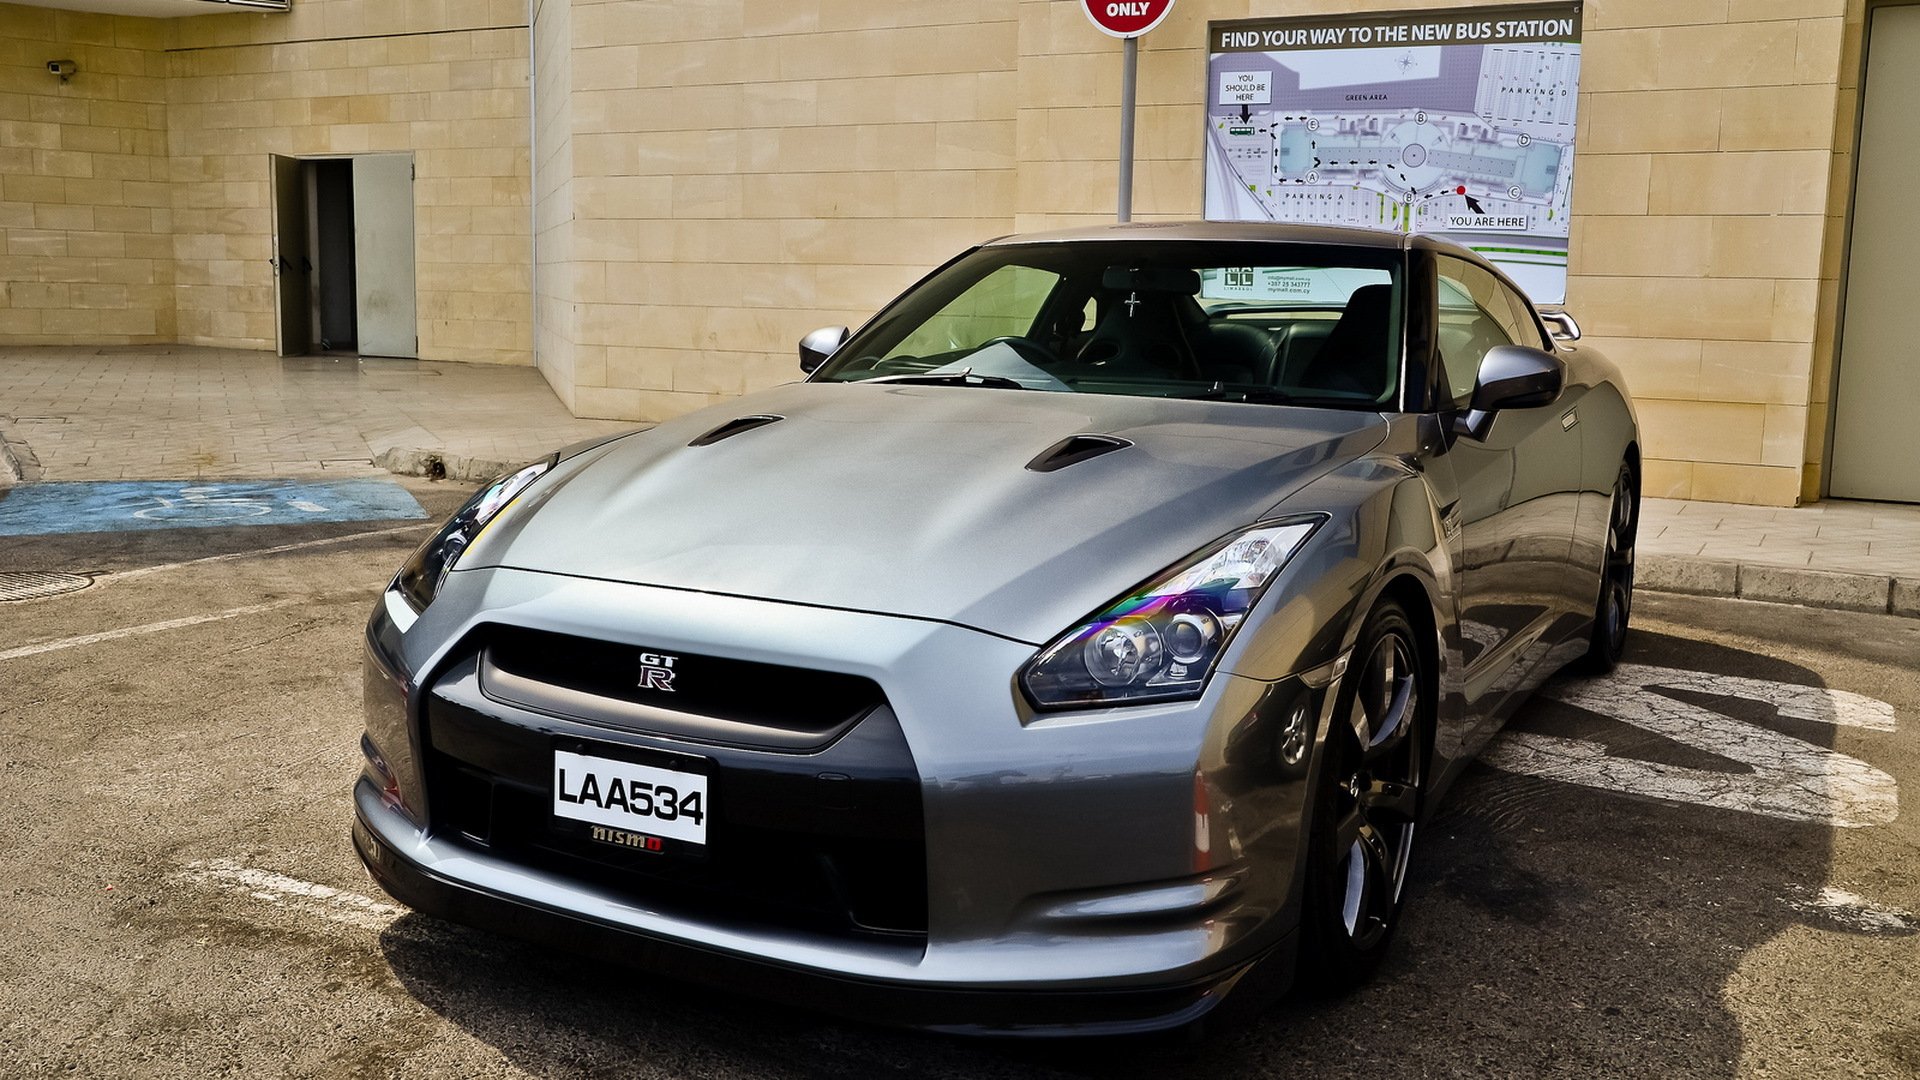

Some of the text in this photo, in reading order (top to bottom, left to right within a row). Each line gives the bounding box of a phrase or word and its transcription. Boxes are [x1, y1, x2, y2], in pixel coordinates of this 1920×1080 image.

[1106, 2, 1150, 17] ONLY
[1221, 19, 1573, 48] FIND YOUR WAY TO THE NEW BUS STATION
[1225, 83, 1266, 92] SHOULD BE
[1501, 86, 1567, 97] PARKING D
[1236, 93, 1254, 101] HERE
[1450, 216, 1524, 227] YOU ARE HERE
[640, 652, 679, 667] GT
[638, 665, 677, 692] R
[558, 768, 704, 826] LAA534
